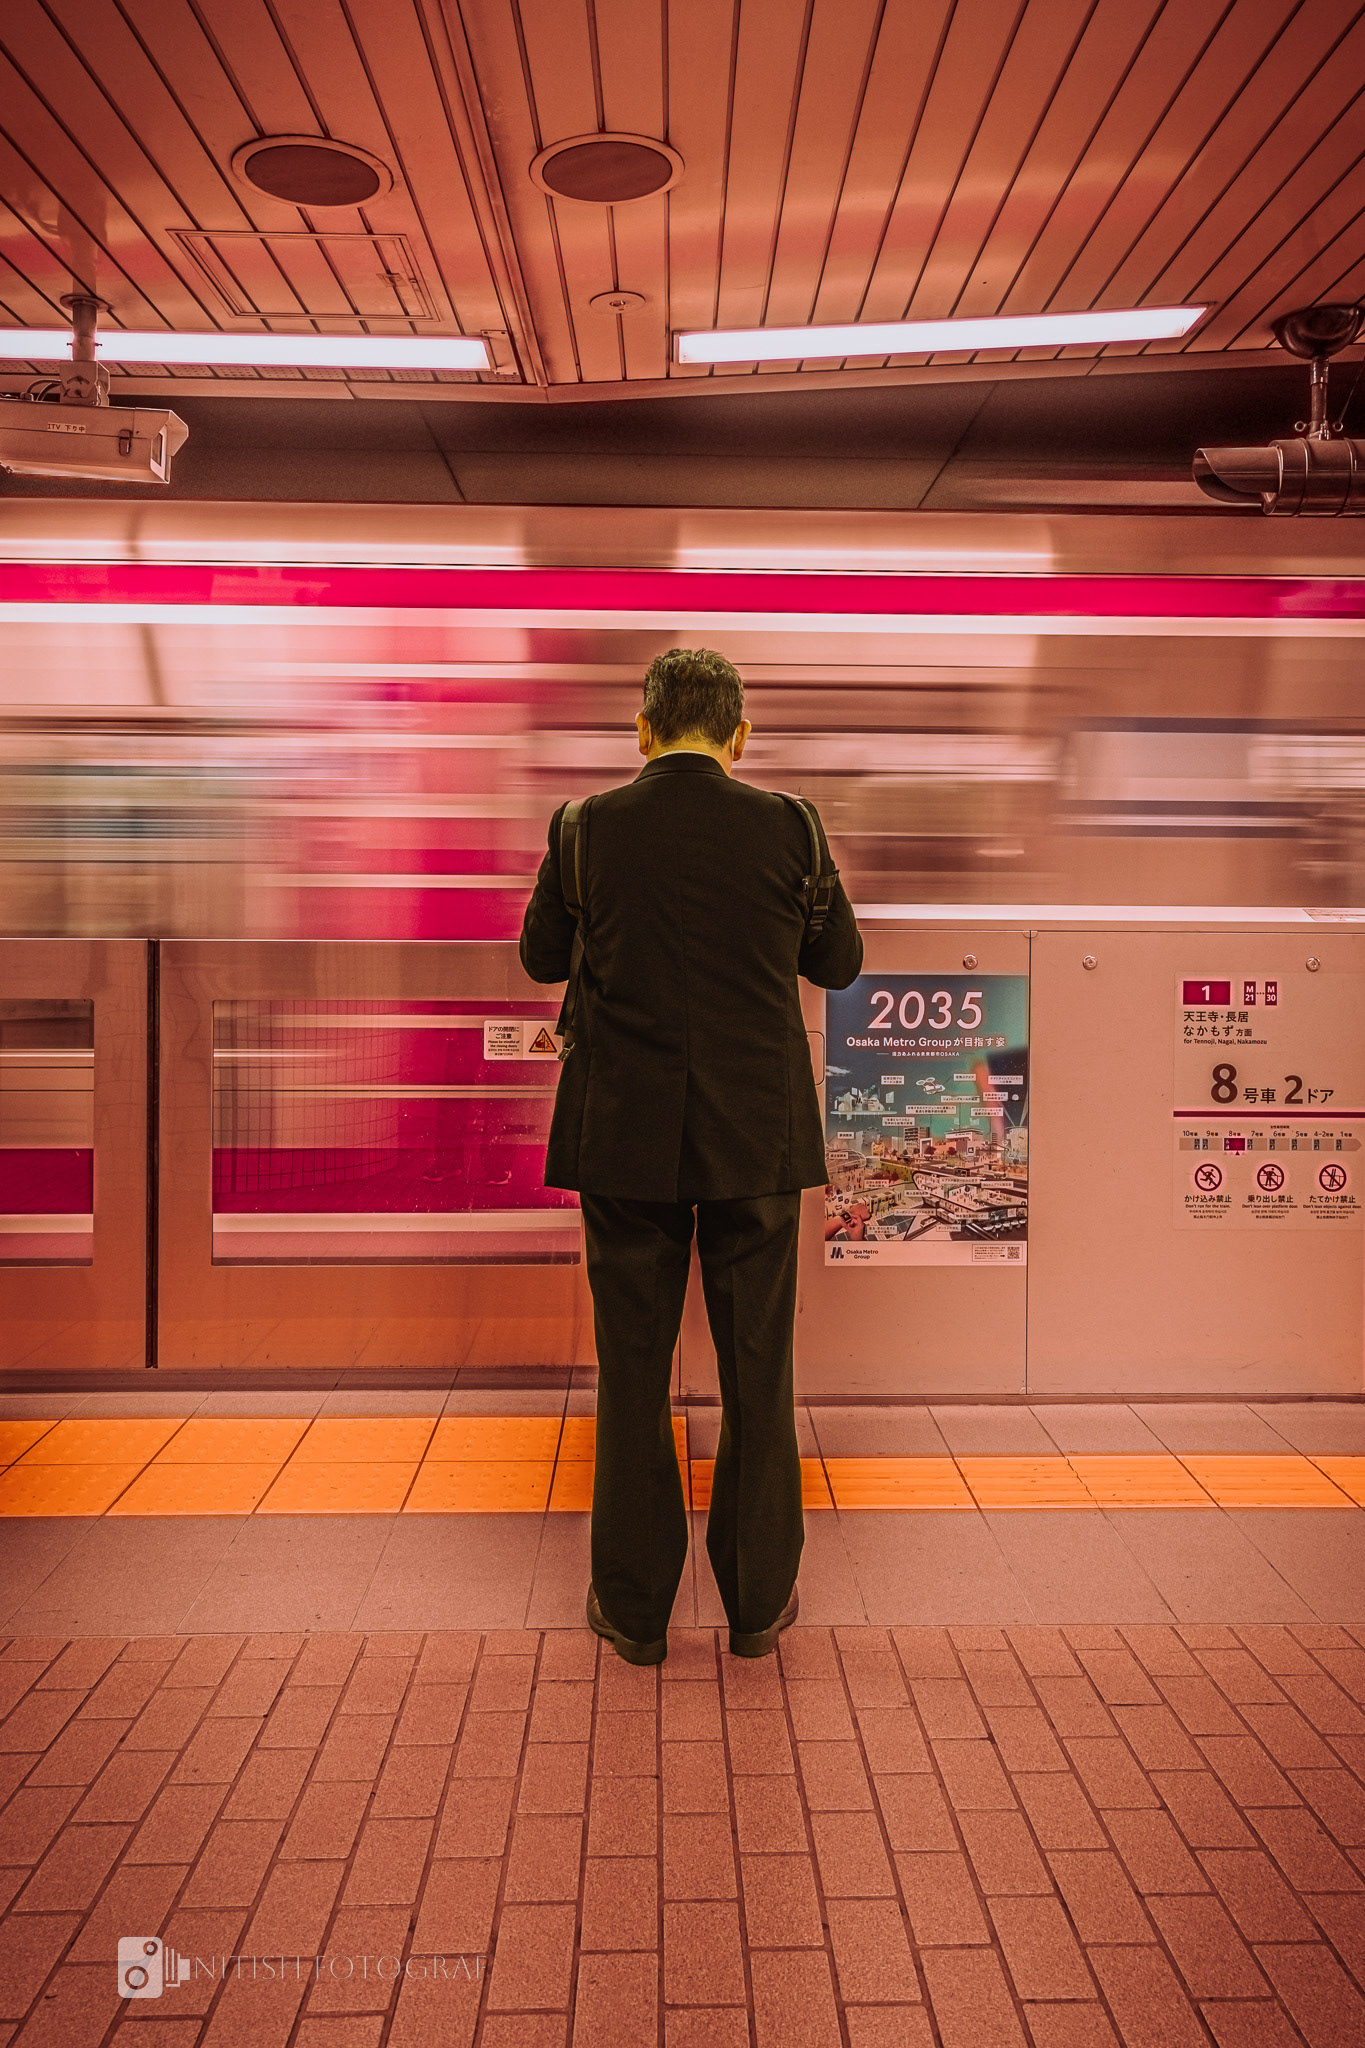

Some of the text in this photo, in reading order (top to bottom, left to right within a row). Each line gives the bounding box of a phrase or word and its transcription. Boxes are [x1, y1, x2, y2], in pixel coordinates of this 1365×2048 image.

[1201, 985, 1211, 1001] 1
[1246, 985, 1254, 993] M
[1267, 985, 1275, 993] M
[1245, 994, 1254, 1002] 21
[1266, 994, 1276, 1002] 30
[867, 990, 983, 1029] 2035
[1183, 1011, 1249, 1023] 天王寺・長居
[846, 1037, 880, 1047] Osaka
[883, 1037, 916, 1047] Metro
[918, 1037, 952, 1049] Group
[1193, 1038, 1217, 1046] Tennoji,
[1217, 1038, 1236, 1046] Nagai,
[1184, 1195, 1232, 1203] かけ込み禁止
[1247, 1195, 1294, 1203] 乗り出し禁止
[1309, 1195, 1356, 1203] たてかけ禁止
